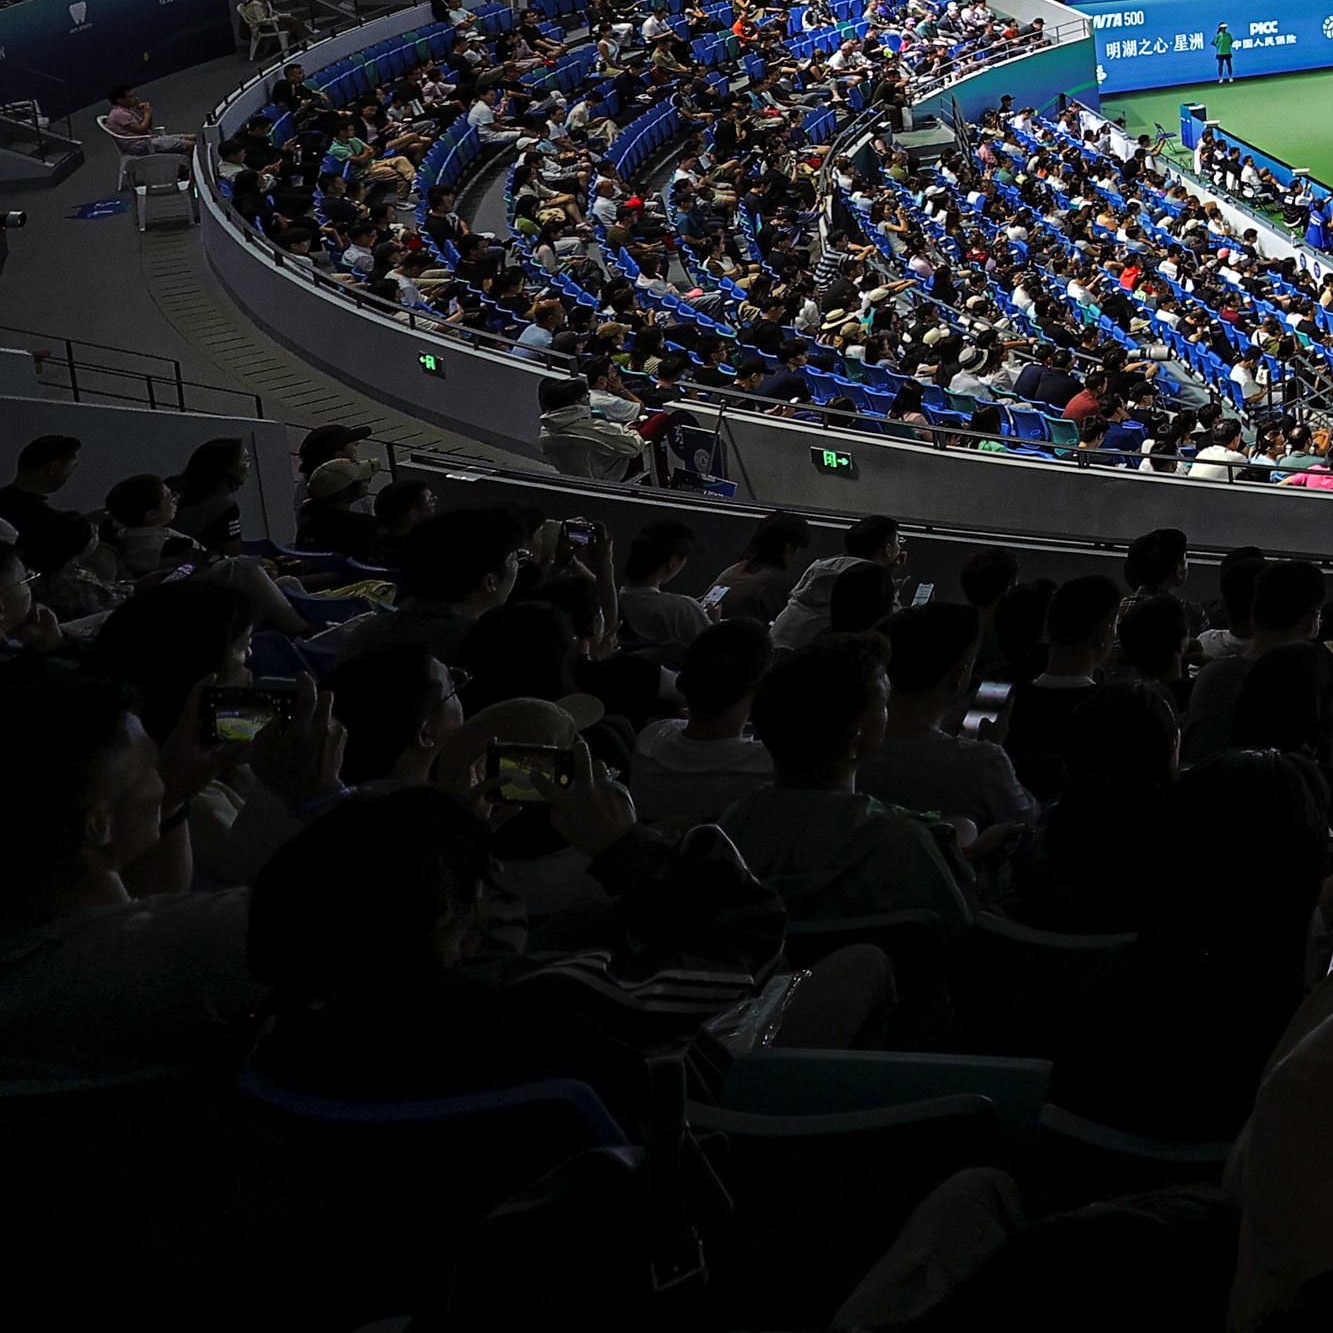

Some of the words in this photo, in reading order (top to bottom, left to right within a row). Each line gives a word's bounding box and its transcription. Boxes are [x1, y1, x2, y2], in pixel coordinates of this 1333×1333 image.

[1123, 10, 1144, 27] 500
[1249, 21, 1279, 35] PICC
[1106, 32, 1204, 60] 明湖之心·星洲
[1232, 34, 1297, 51] 中国人民保险
